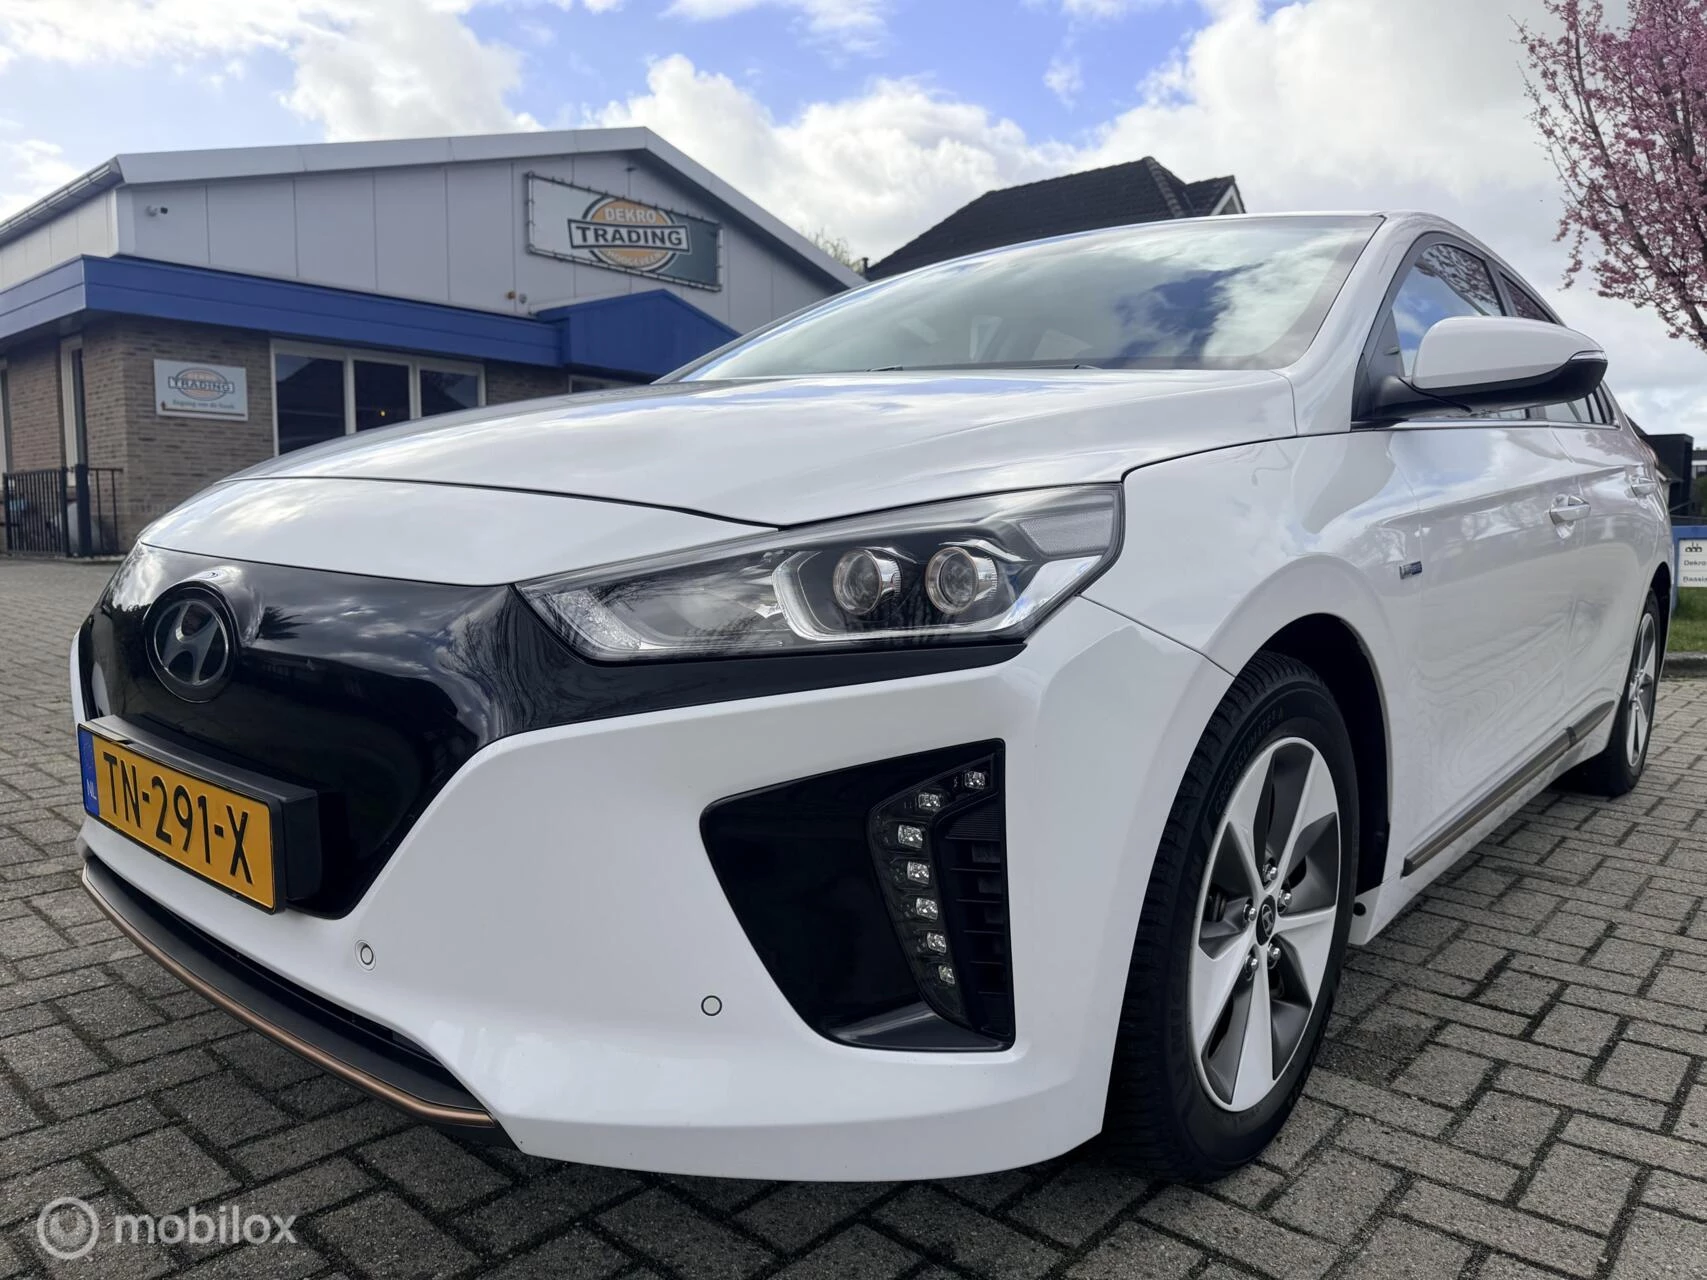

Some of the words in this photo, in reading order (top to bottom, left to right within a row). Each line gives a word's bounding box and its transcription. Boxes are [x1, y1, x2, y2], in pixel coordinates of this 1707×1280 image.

[605, 208, 657, 223] DEKRO
[575, 225, 683, 247] TRADING
[171, 378, 231, 392] TRADING
[86, 778, 98, 800] NL
[102, 751, 254, 886] TN-291-X
